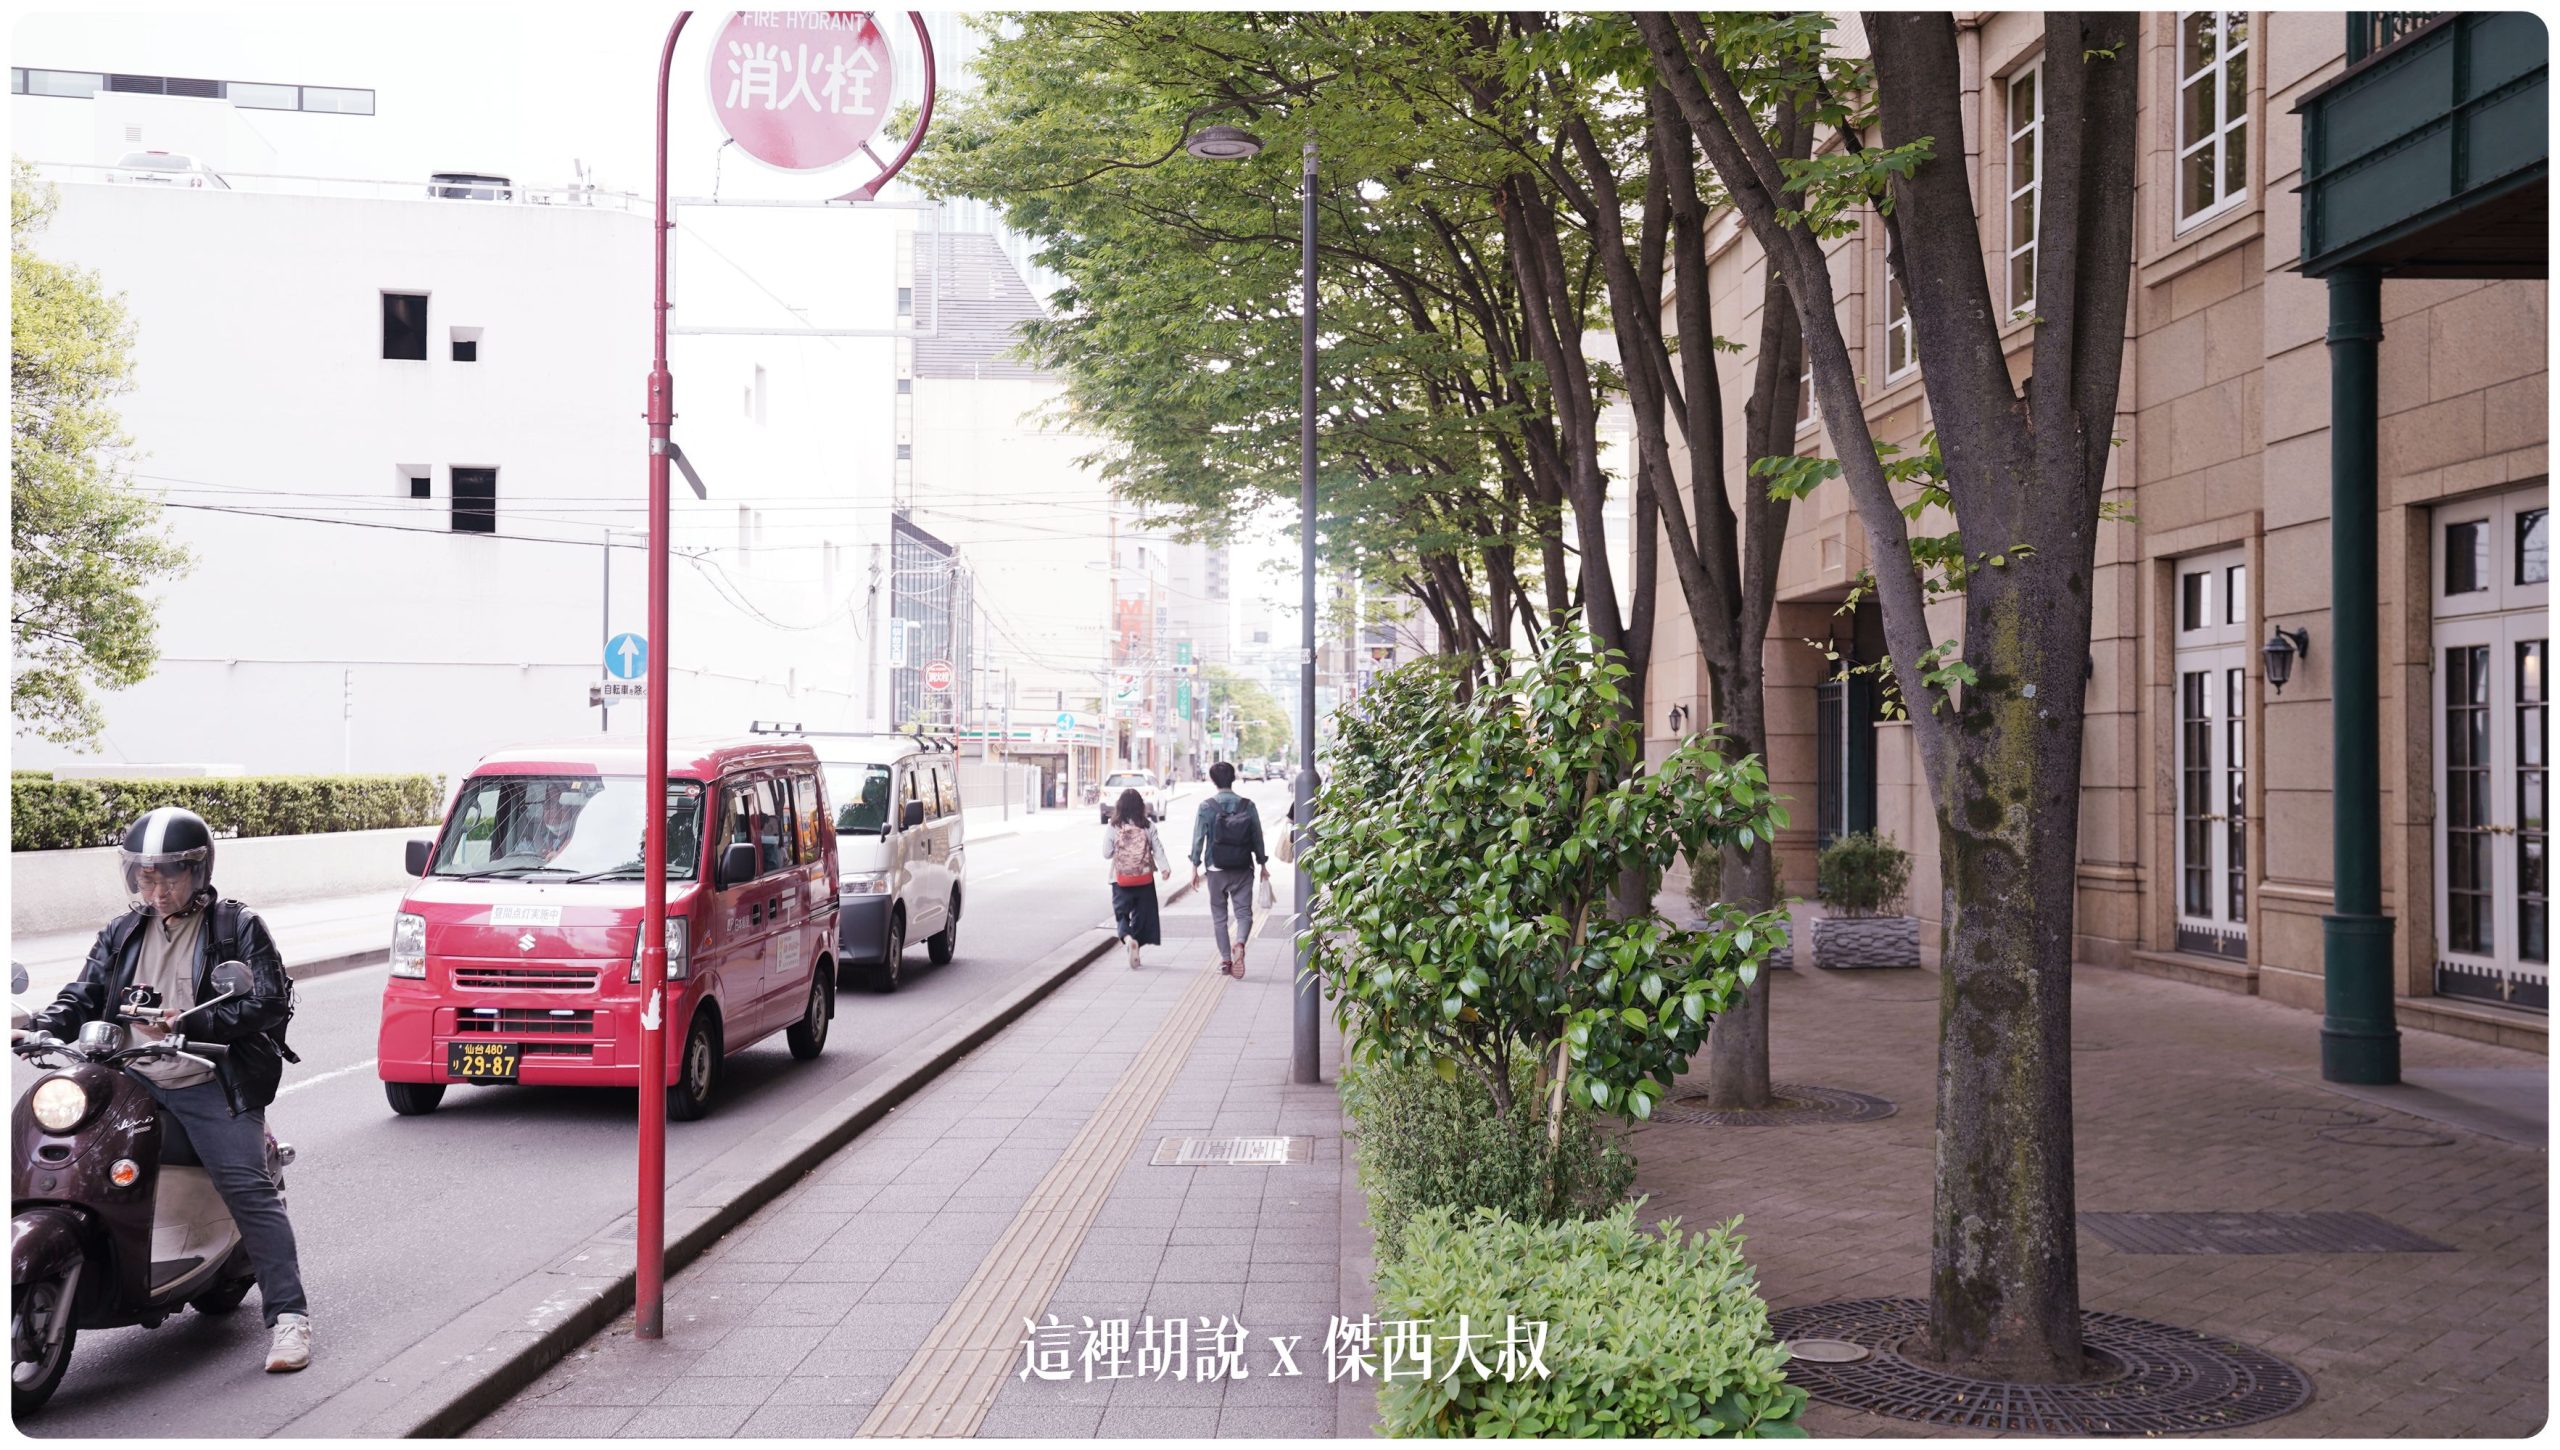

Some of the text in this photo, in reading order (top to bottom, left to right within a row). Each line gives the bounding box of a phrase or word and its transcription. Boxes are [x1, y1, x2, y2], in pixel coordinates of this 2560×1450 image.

[743, 11, 865, 32] FIRE HYDRANT
[725, 40, 880, 116] 消火栓
[604, 684, 648, 696] 自転車を除く
[465, 1044, 503, 1055] 仙台 480
[452, 1055, 515, 1076] り 29-87
